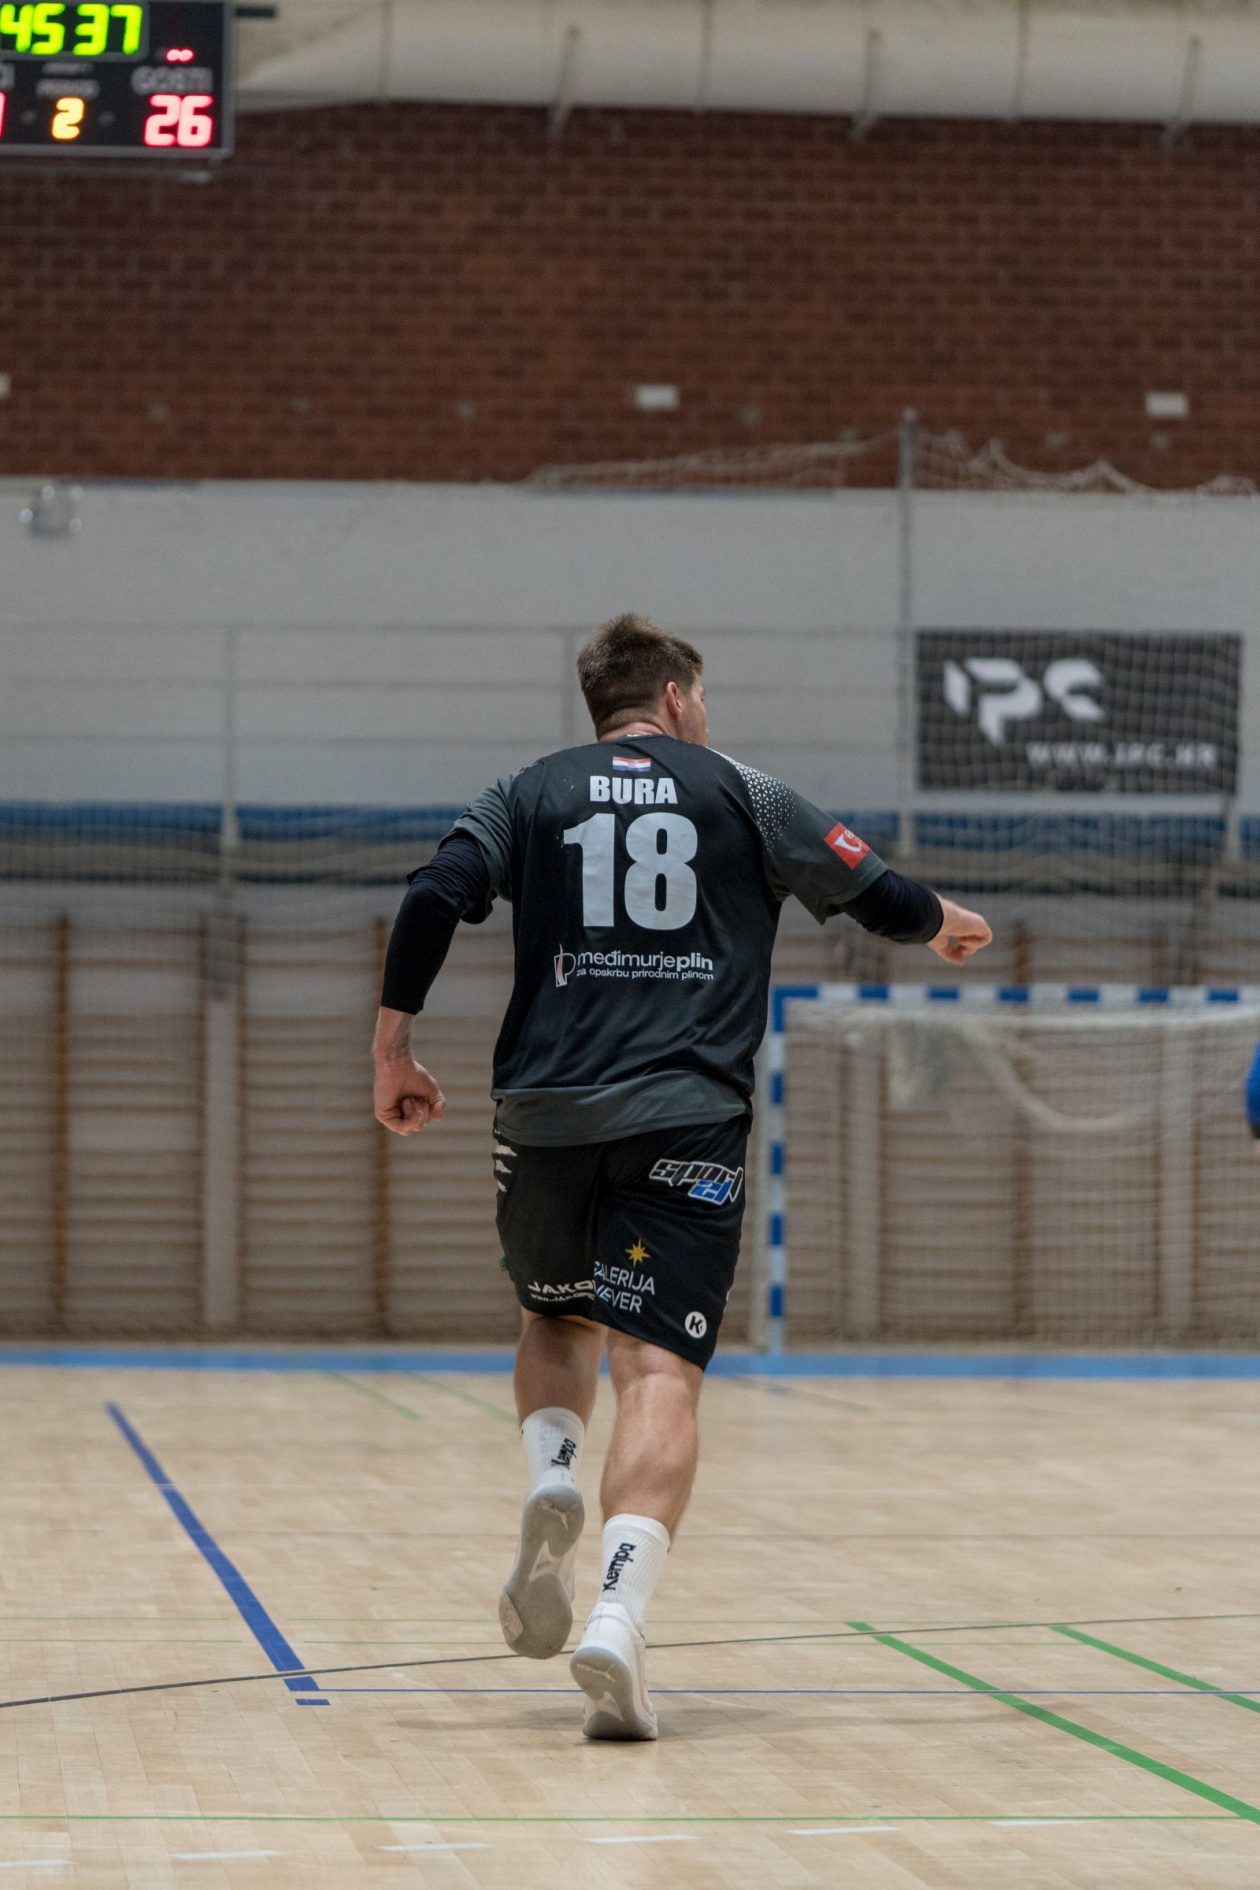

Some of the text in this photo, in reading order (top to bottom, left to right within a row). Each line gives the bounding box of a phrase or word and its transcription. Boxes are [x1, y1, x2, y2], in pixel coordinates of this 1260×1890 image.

[52, 97, 85, 140] 2
[144, 95, 213, 147] 26
[590, 776, 678, 804] BURA
[563, 812, 698, 930] 18
[576, 967, 714, 981] za opskrbu prirodnim plinom
[527, 1279, 597, 1295] JAKO
[601, 1542, 637, 1592] Kempa
